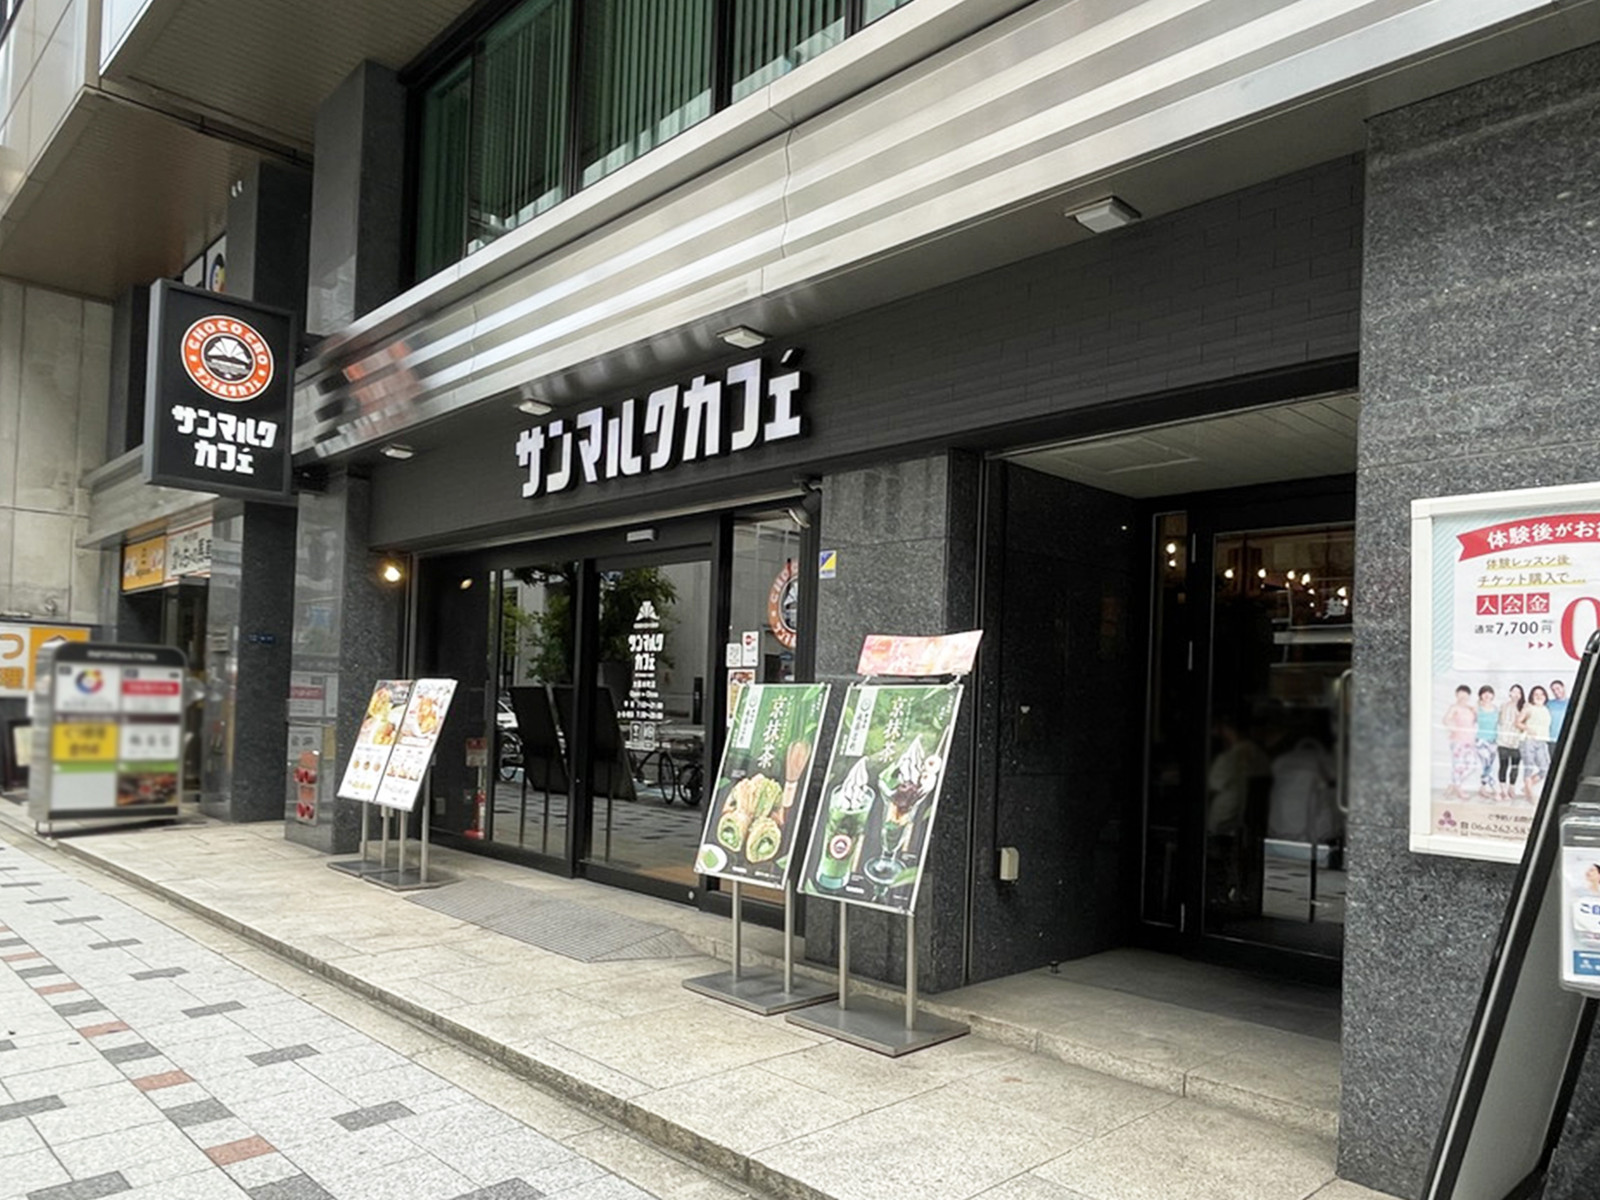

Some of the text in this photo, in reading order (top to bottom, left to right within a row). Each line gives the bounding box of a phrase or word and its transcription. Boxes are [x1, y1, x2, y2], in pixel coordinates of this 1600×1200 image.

[171, 405, 277, 448] サンマルク
[515, 349, 801, 498] サンマルクカフェ
[194, 440, 254, 475] カフェ
[1487, 521, 1600, 550] 体験後がお
[1478, 595, 1549, 613] 入会金
